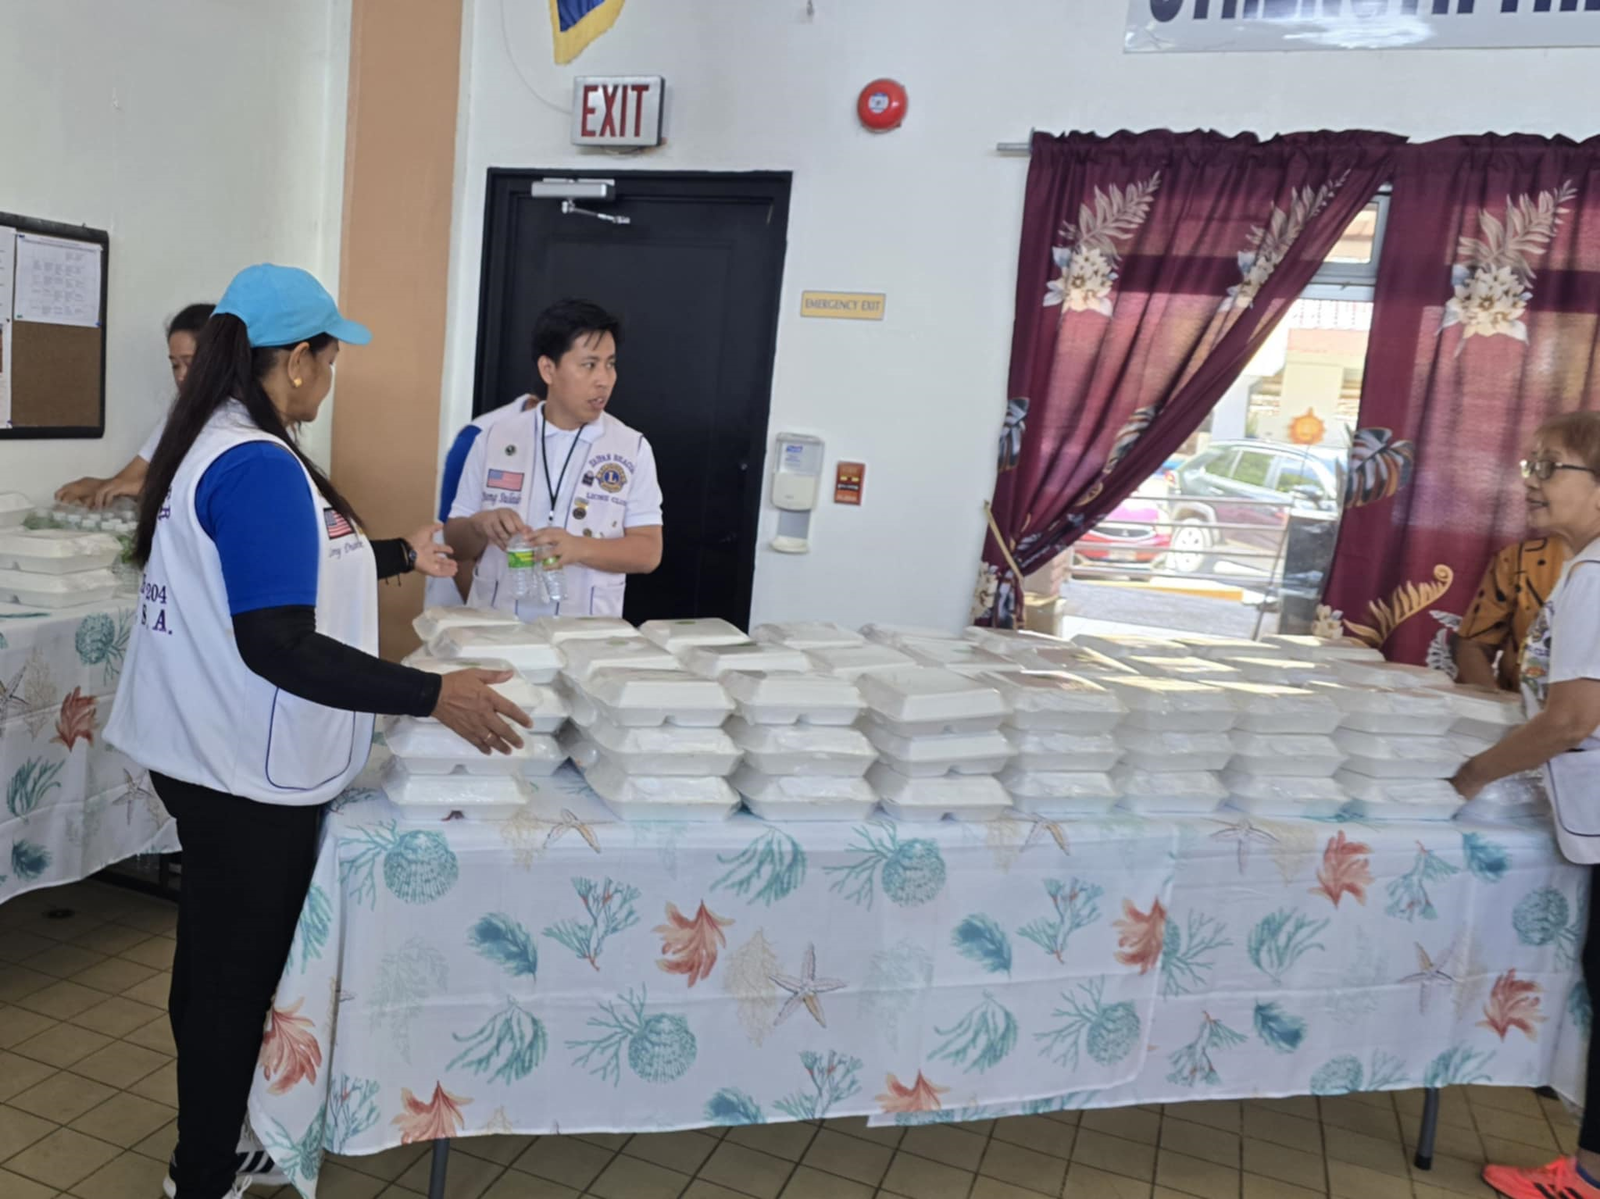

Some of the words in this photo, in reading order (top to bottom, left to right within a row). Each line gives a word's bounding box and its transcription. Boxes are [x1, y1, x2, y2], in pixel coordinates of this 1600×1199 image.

[581, 84, 649, 137] EXIT
[805, 298, 858, 311] EMERGENCY
[861, 300, 881, 312] EXIT
